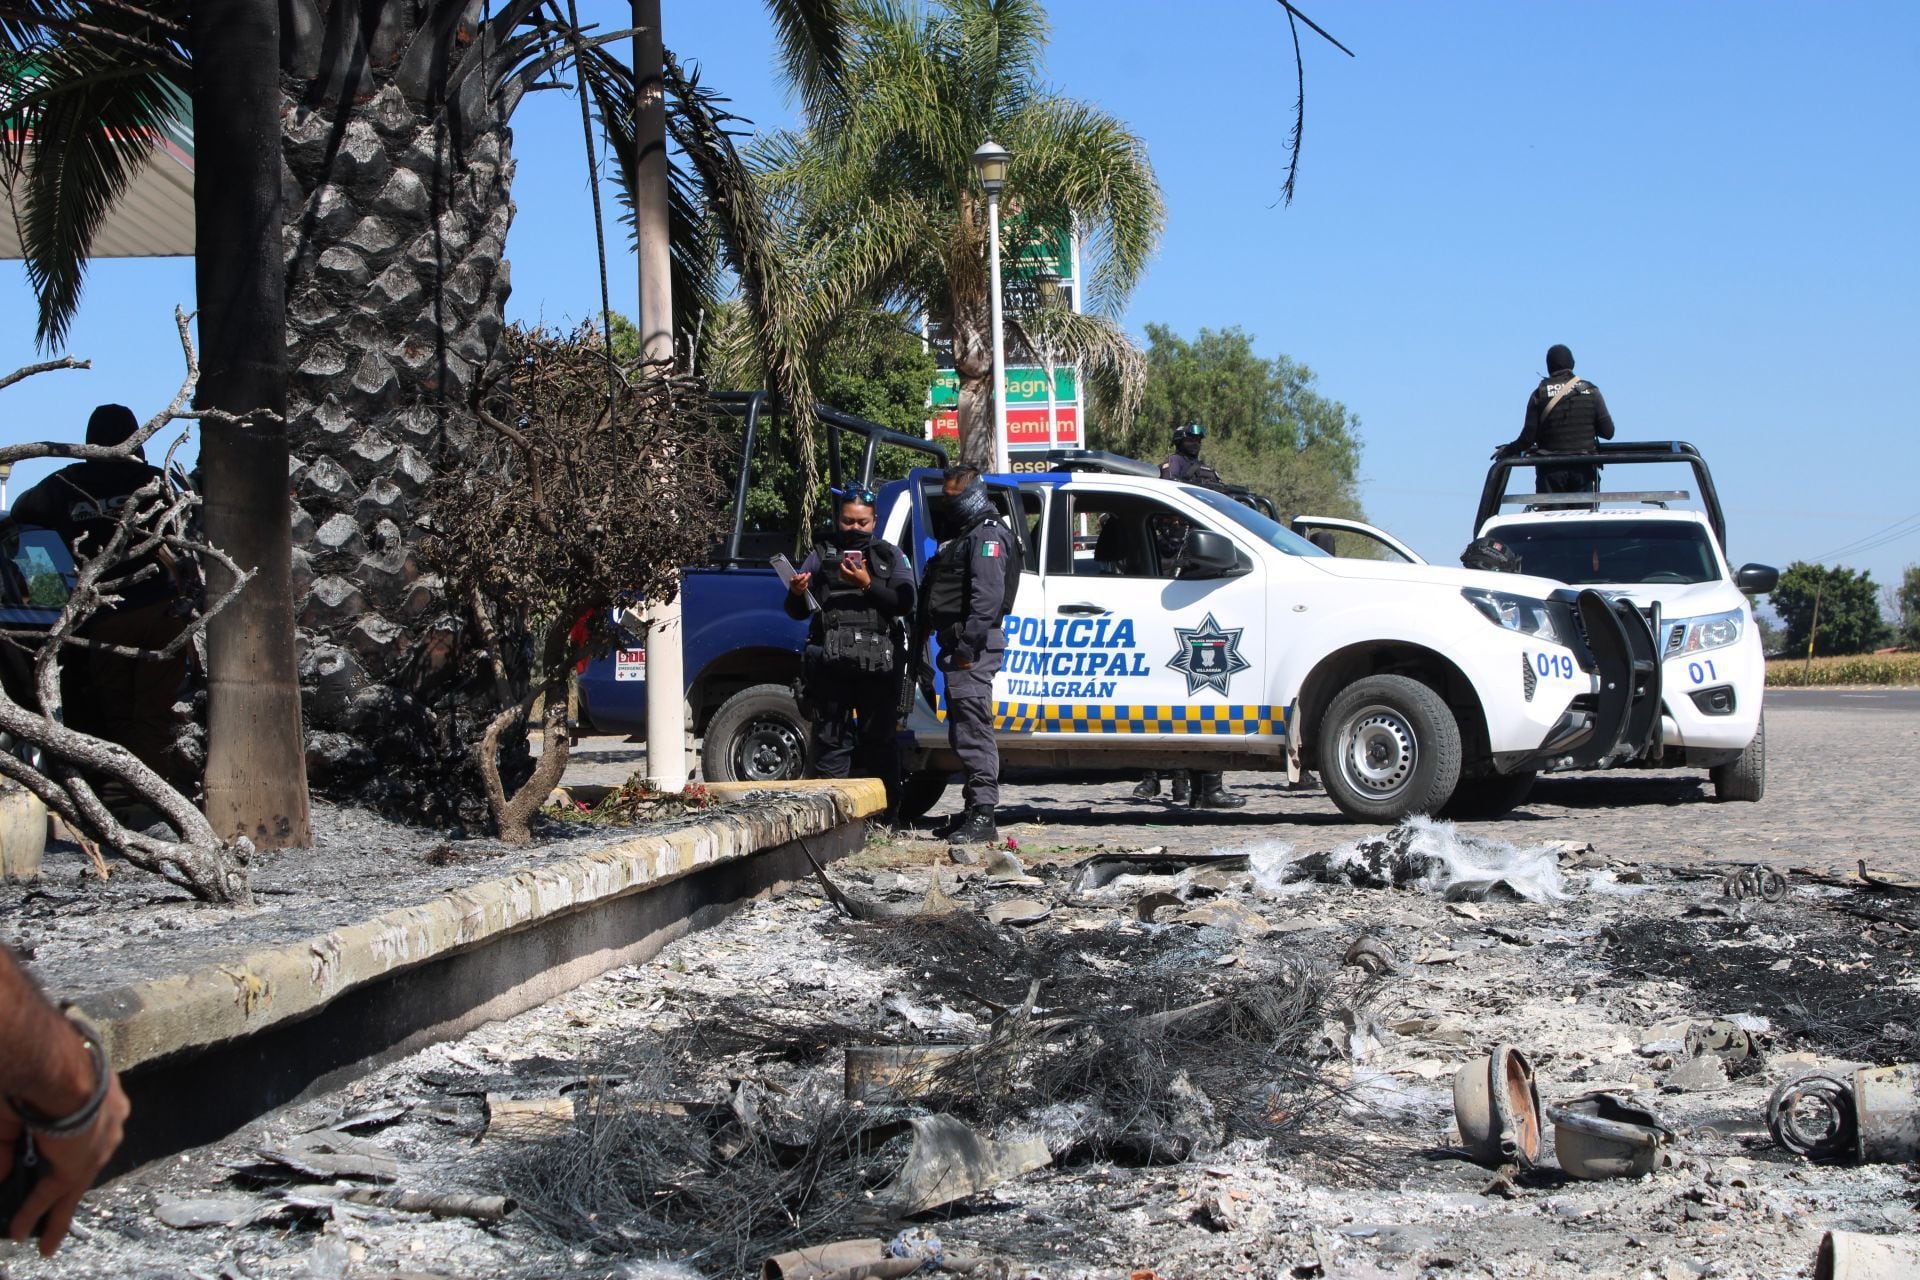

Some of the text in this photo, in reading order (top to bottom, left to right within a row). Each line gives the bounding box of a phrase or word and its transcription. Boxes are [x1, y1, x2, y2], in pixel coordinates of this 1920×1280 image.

[1003, 611, 1136, 649] POLICÍA
[1536, 652, 1574, 680] 019
[1007, 677, 1118, 698] VILLAGRÁN
